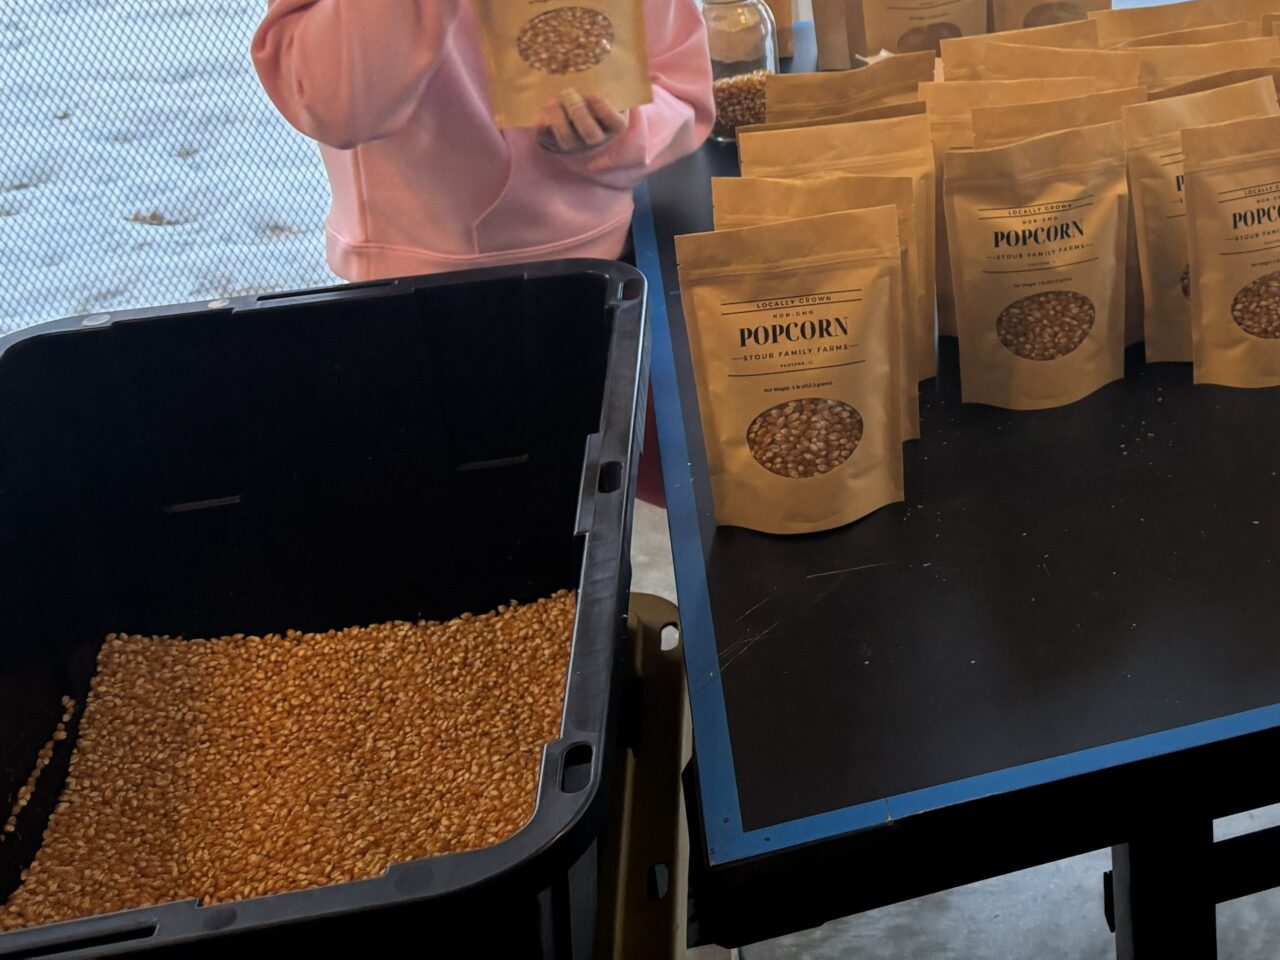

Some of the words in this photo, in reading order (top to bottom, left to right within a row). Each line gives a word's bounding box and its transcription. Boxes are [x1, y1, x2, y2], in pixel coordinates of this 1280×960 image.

[993, 219, 1084, 248] POPCORN
[756, 299, 795, 309] LOCALLY
[799, 295, 832, 304] GROWN
[738, 316, 849, 348] POPCORN
[779, 348, 813, 357] FAMILY
[817, 344, 849, 353] FARMS
